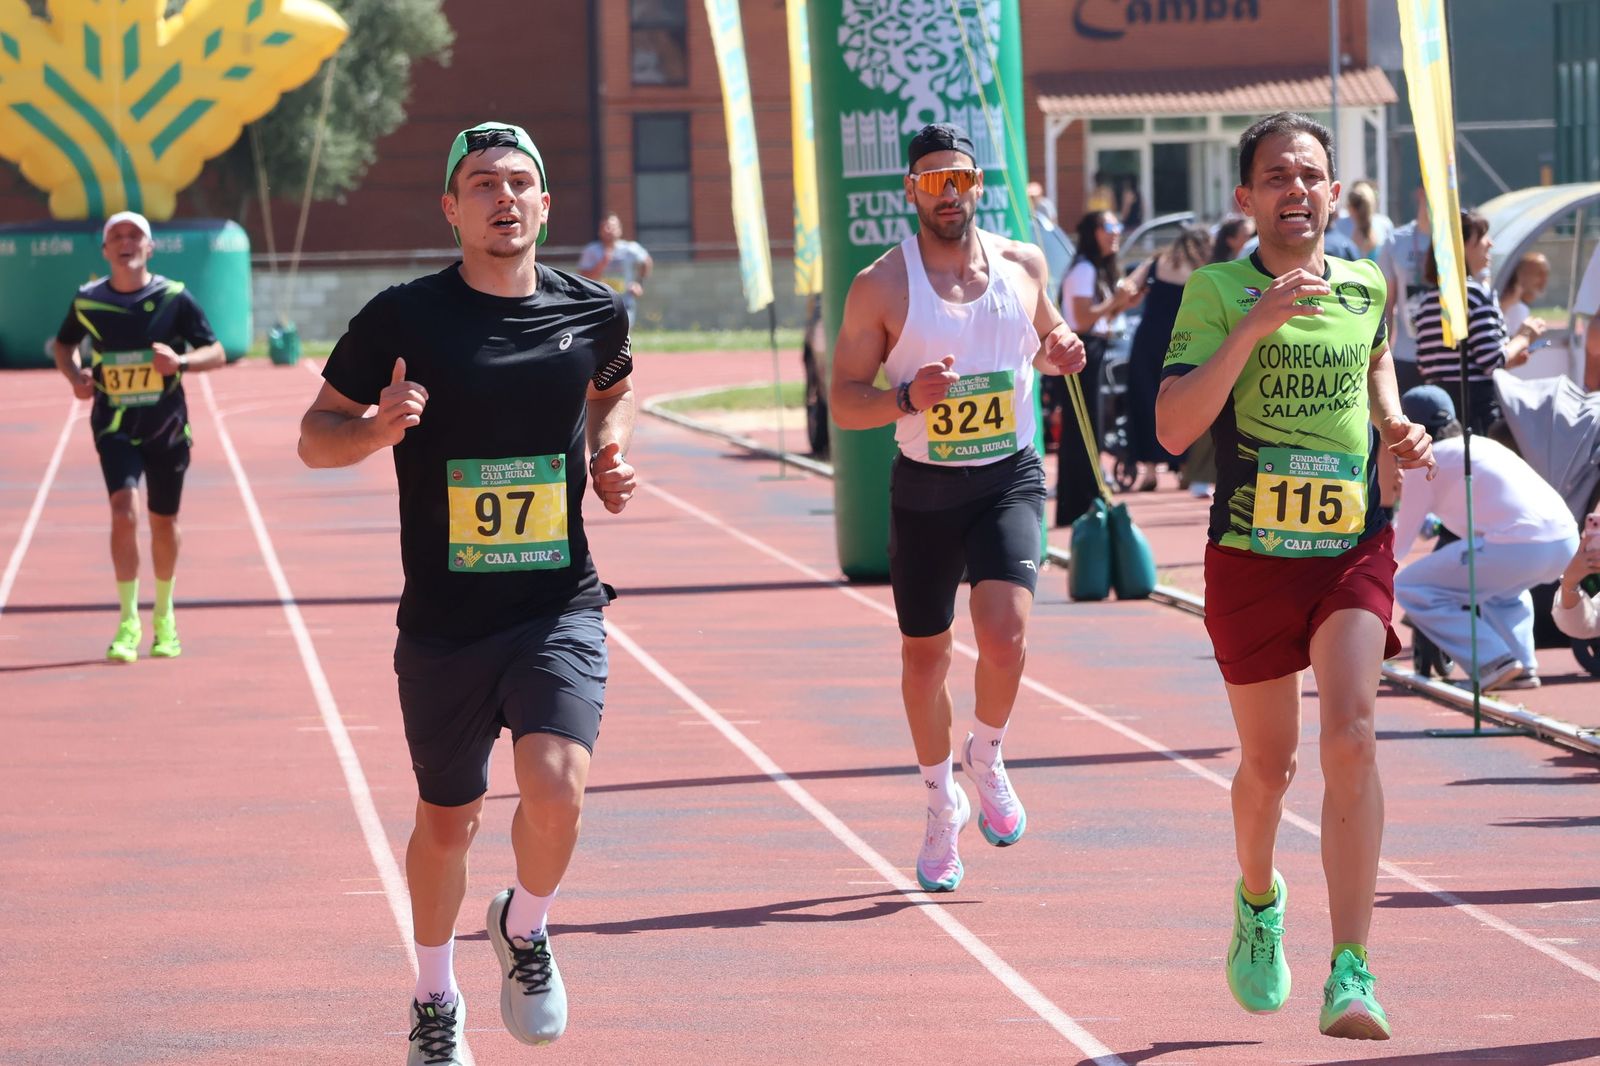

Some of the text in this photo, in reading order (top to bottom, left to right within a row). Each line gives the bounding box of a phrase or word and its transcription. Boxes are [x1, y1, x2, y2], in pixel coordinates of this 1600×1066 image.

[1258, 343, 1370, 369] CORRECAMINO
[108, 367, 151, 390] 377
[931, 396, 1004, 436] 324
[955, 439, 1013, 456] CAJA RURAL
[481, 470, 535, 480] CAJA RURAL
[1289, 461, 1339, 472] CAJA RURAL
[1269, 480, 1343, 526] 115
[475, 491, 535, 537] 97
[1285, 539, 1351, 550] CAJA RURA
[485, 549, 564, 564] CAJA RURA
